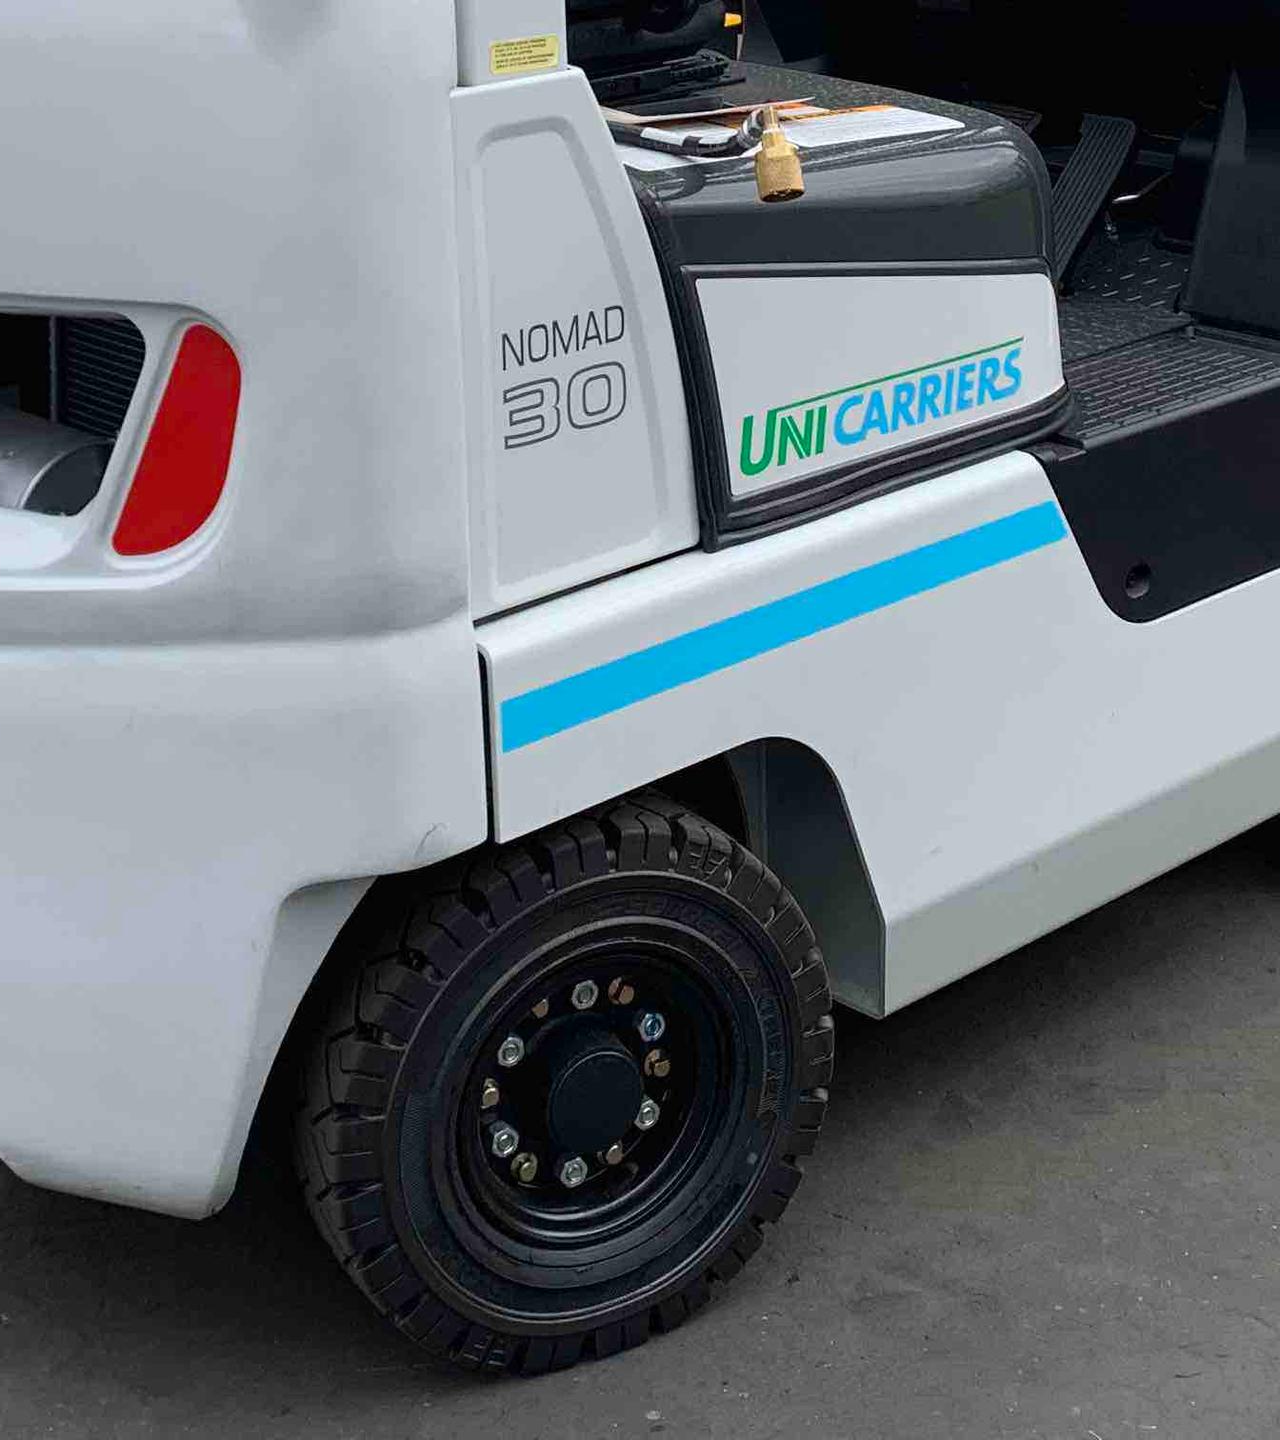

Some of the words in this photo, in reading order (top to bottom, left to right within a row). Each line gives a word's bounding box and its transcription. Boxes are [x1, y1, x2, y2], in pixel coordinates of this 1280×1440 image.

[501, 304, 625, 372] NOMAD
[502, 361, 627, 450] 30
[740, 347, 1023, 476] UNICARRIERS
